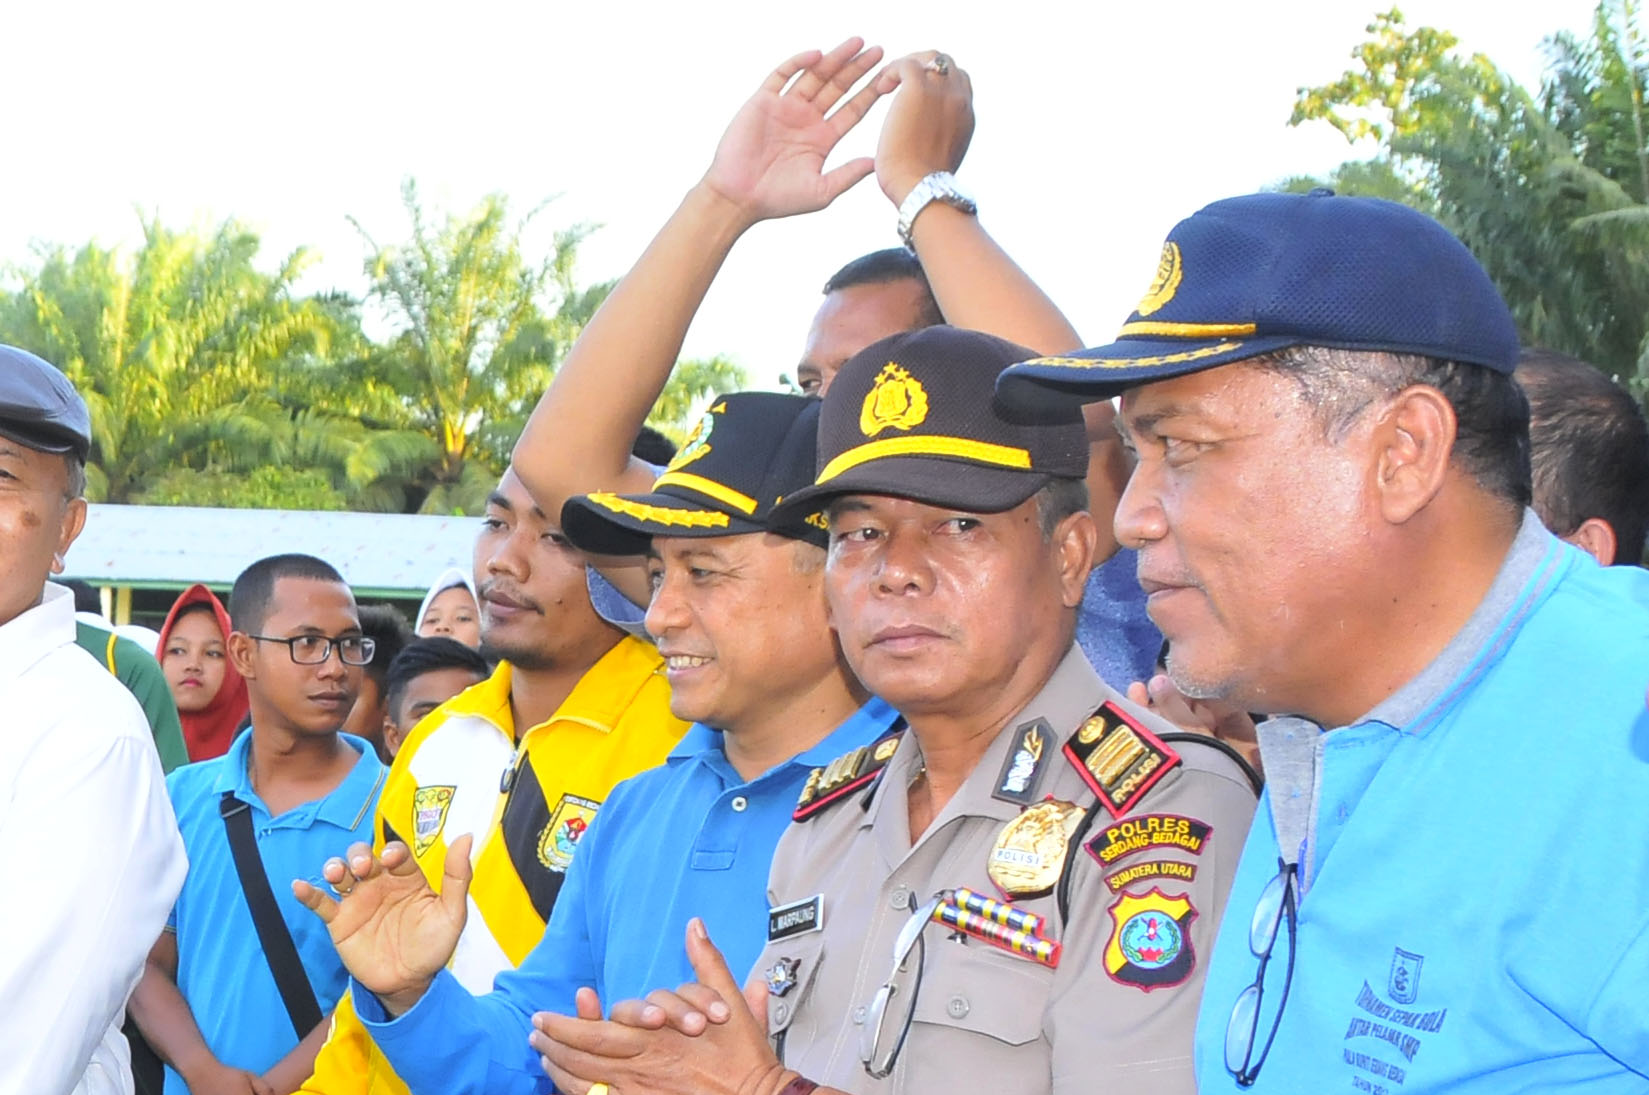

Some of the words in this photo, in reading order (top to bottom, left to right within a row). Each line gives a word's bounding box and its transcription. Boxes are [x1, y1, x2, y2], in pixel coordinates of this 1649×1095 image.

[1106, 817, 1190, 844] POLRES
[997, 850, 1040, 865] POLISI
[1110, 863, 1160, 889] SUMATERA
[1160, 863, 1192, 878] UTARA
